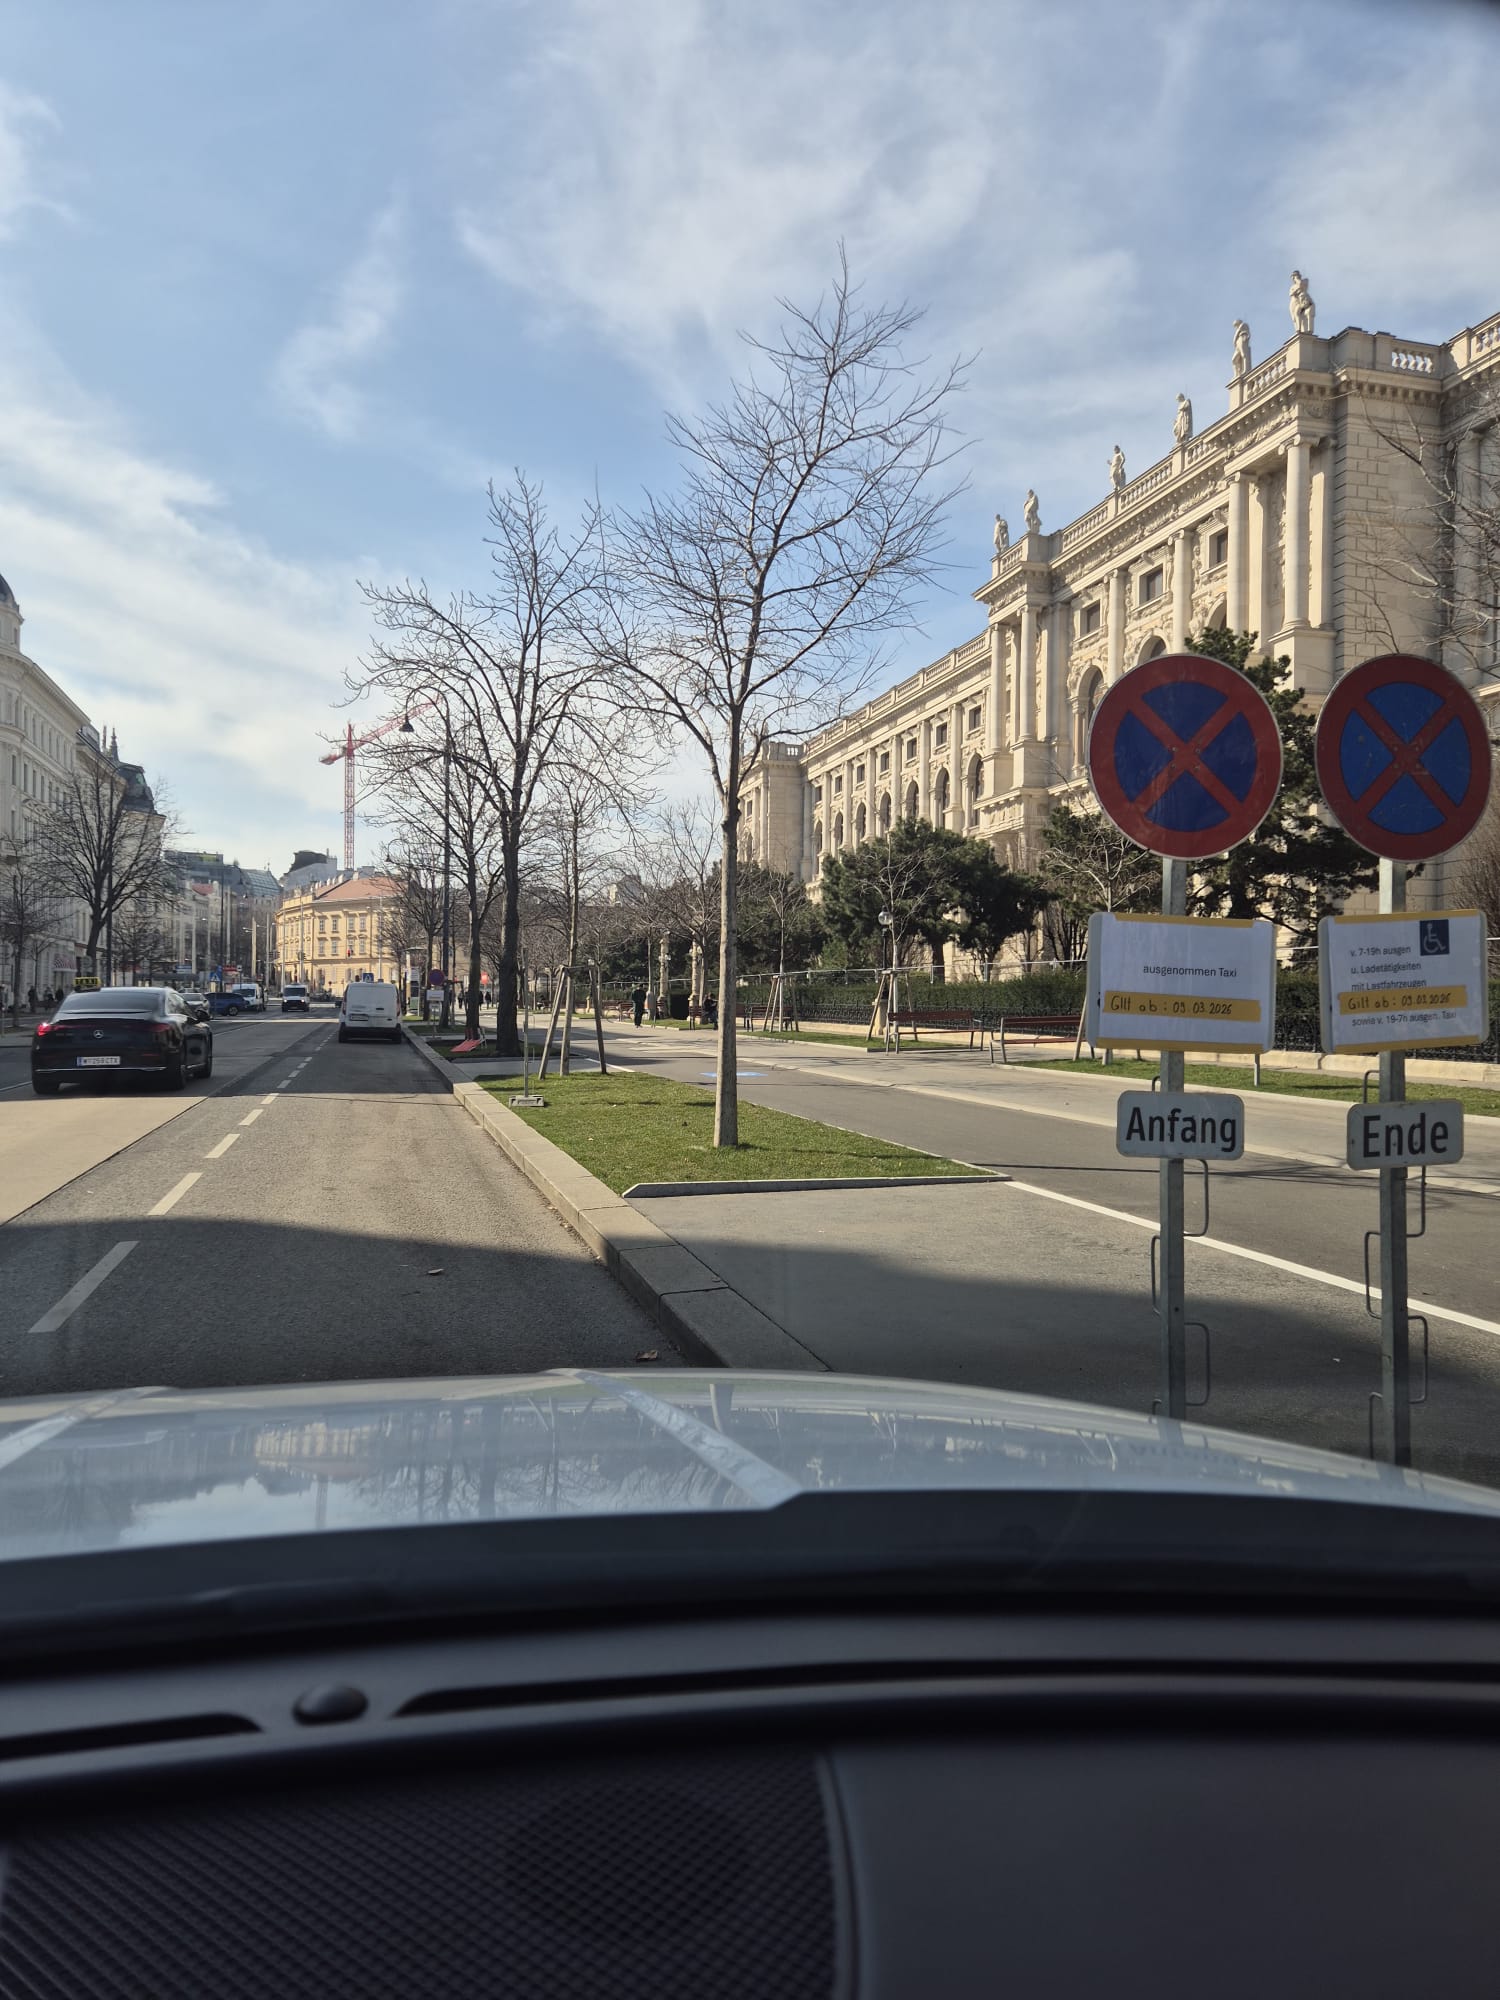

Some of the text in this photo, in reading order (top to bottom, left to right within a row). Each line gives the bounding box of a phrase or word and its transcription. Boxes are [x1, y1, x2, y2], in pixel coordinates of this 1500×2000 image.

[1143, 965, 1237, 977] ausgenommen Taxi
[1360, 962, 1421, 974] Ladetätigkeiten
[1351, 979, 1427, 992] mit Lastfahrzeugen
[1110, 995, 1131, 1012] Gilt
[1347, 996, 1369, 1010] Gilt
[1441, 1010, 1457, 1020] Taxi
[1125, 1106, 1236, 1153] Anfang
[1363, 1112, 1449, 1158] Ende
